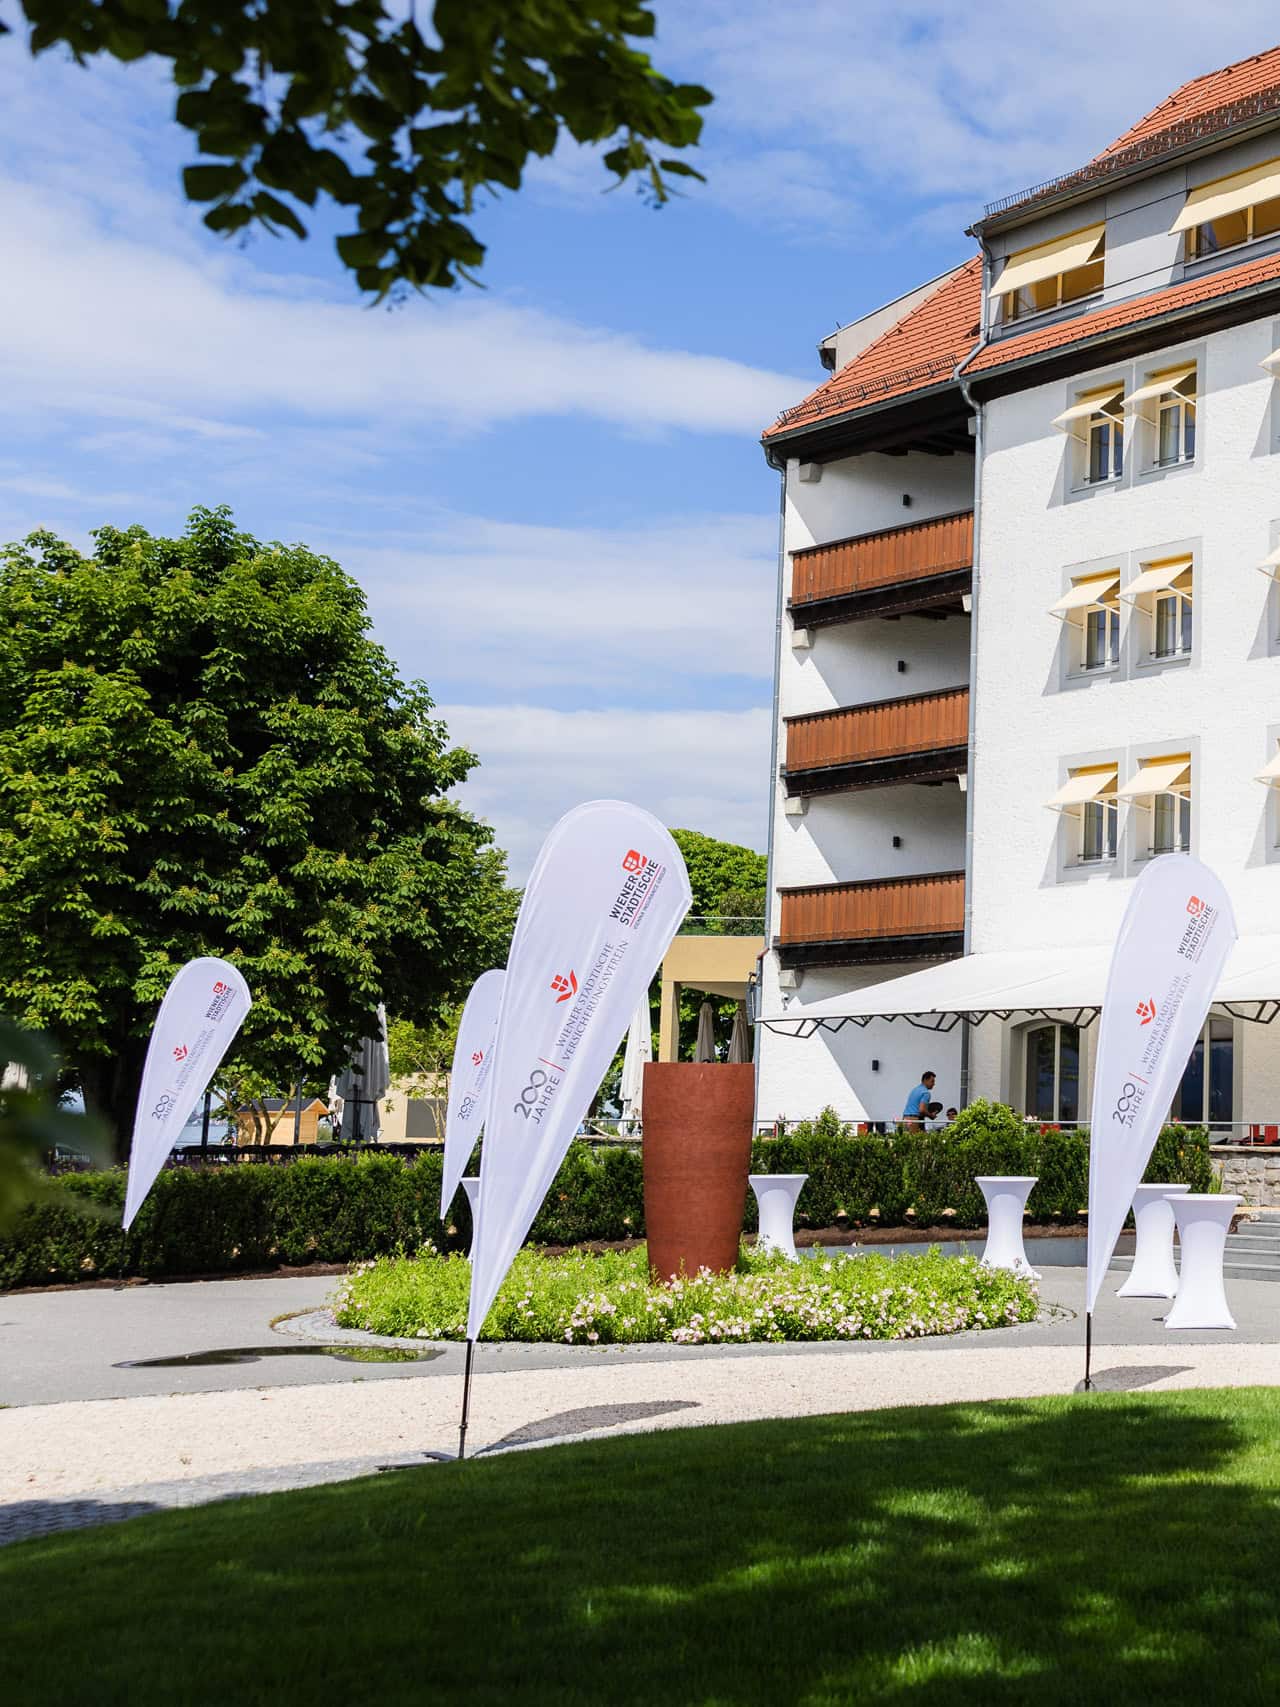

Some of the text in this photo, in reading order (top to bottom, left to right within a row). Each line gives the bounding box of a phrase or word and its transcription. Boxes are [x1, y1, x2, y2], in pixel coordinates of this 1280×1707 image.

[609, 874, 638, 919] WIENER
[619, 859, 659, 925] STÄDTISCHE
[1177, 917, 1199, 954] WIENER
[562, 940, 629, 1061] VERSICHERUNGSVEREIN
[556, 1004, 582, 1049] WIENER
[513, 1069, 548, 1119] 200
[531, 1075, 561, 1124] JAHRE
[1112, 1082, 1136, 1124] 200
[1125, 1087, 1146, 1129] JAHRE
